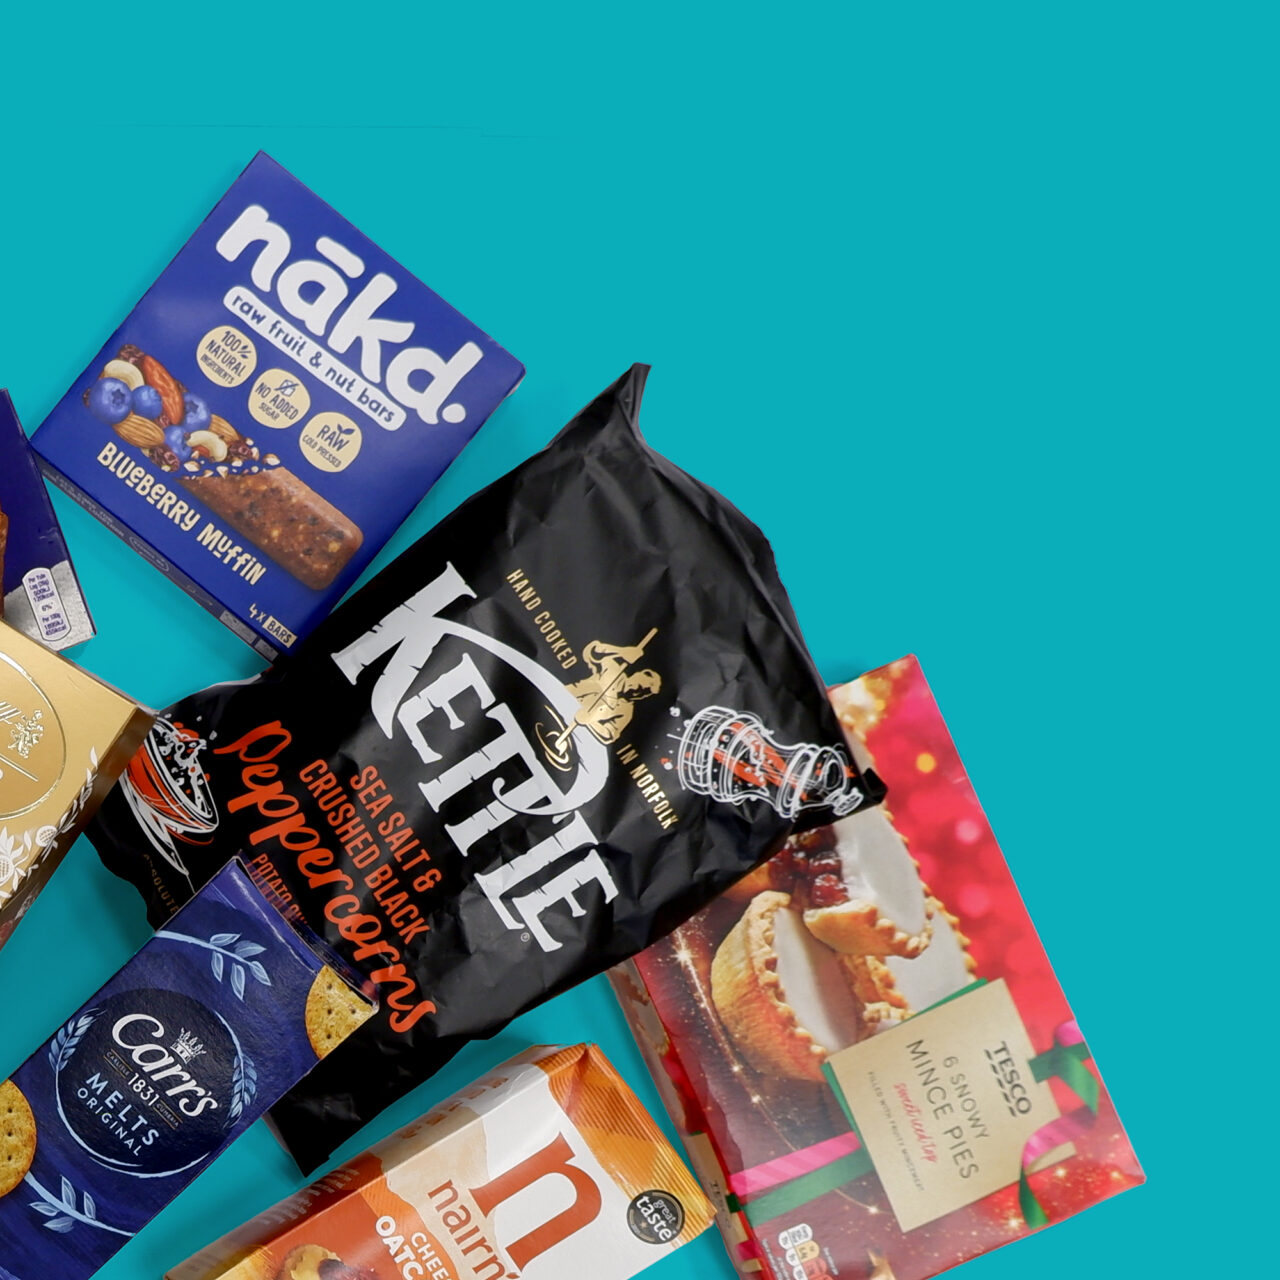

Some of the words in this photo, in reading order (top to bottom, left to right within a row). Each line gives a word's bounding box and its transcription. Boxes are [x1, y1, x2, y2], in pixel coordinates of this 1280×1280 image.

[200, 353, 236, 385] INGREDIENTS
[205, 339, 247, 377] NATURAL
[232, 295, 266, 326] raw
[270, 321, 308, 358] fruit
[309, 351, 323, 370] &
[325, 366, 356, 394] nut
[357, 387, 395, 423] bars
[254, 382, 271, 399] NO
[270, 395, 299, 420] ADDED
[258, 402, 280, 421] SUGAR
[302, 434, 318, 450] COLD
[316, 445, 342, 468] PRESSED
[316, 424, 350, 452] RAW
[267, 620, 293, 643] BARS
[506, 568, 541, 612] HAND
[533, 610, 578, 671] COOKED
[330, 560, 620, 953] KETTLE
[615, 743, 632, 764] IN
[628, 760, 681, 831] NORFOLK
[298, 758, 380, 870] CRUSHED
[364, 858, 432, 946] BLACK
[349, 765, 388, 820] SEA
[377, 810, 432, 872] SALT
[412, 867, 443, 894] &
[111, 1013, 218, 1117] Carr's
[128, 1073, 160, 1107] 1831
[942, 1056, 959, 1068] 6
[993, 1041, 1032, 1115] TESCO
[77, 1087, 143, 1157] ORIGINAL
[86, 1072, 160, 1146] MELTS
[906, 1039, 954, 1120] MINCE
[943, 1125, 979, 1179] PIES
[950, 1073, 990, 1139] SNOWY
[468, 1131, 603, 1273] n
[636, 1195, 673, 1242] taste
[653, 1199, 677, 1224] great
